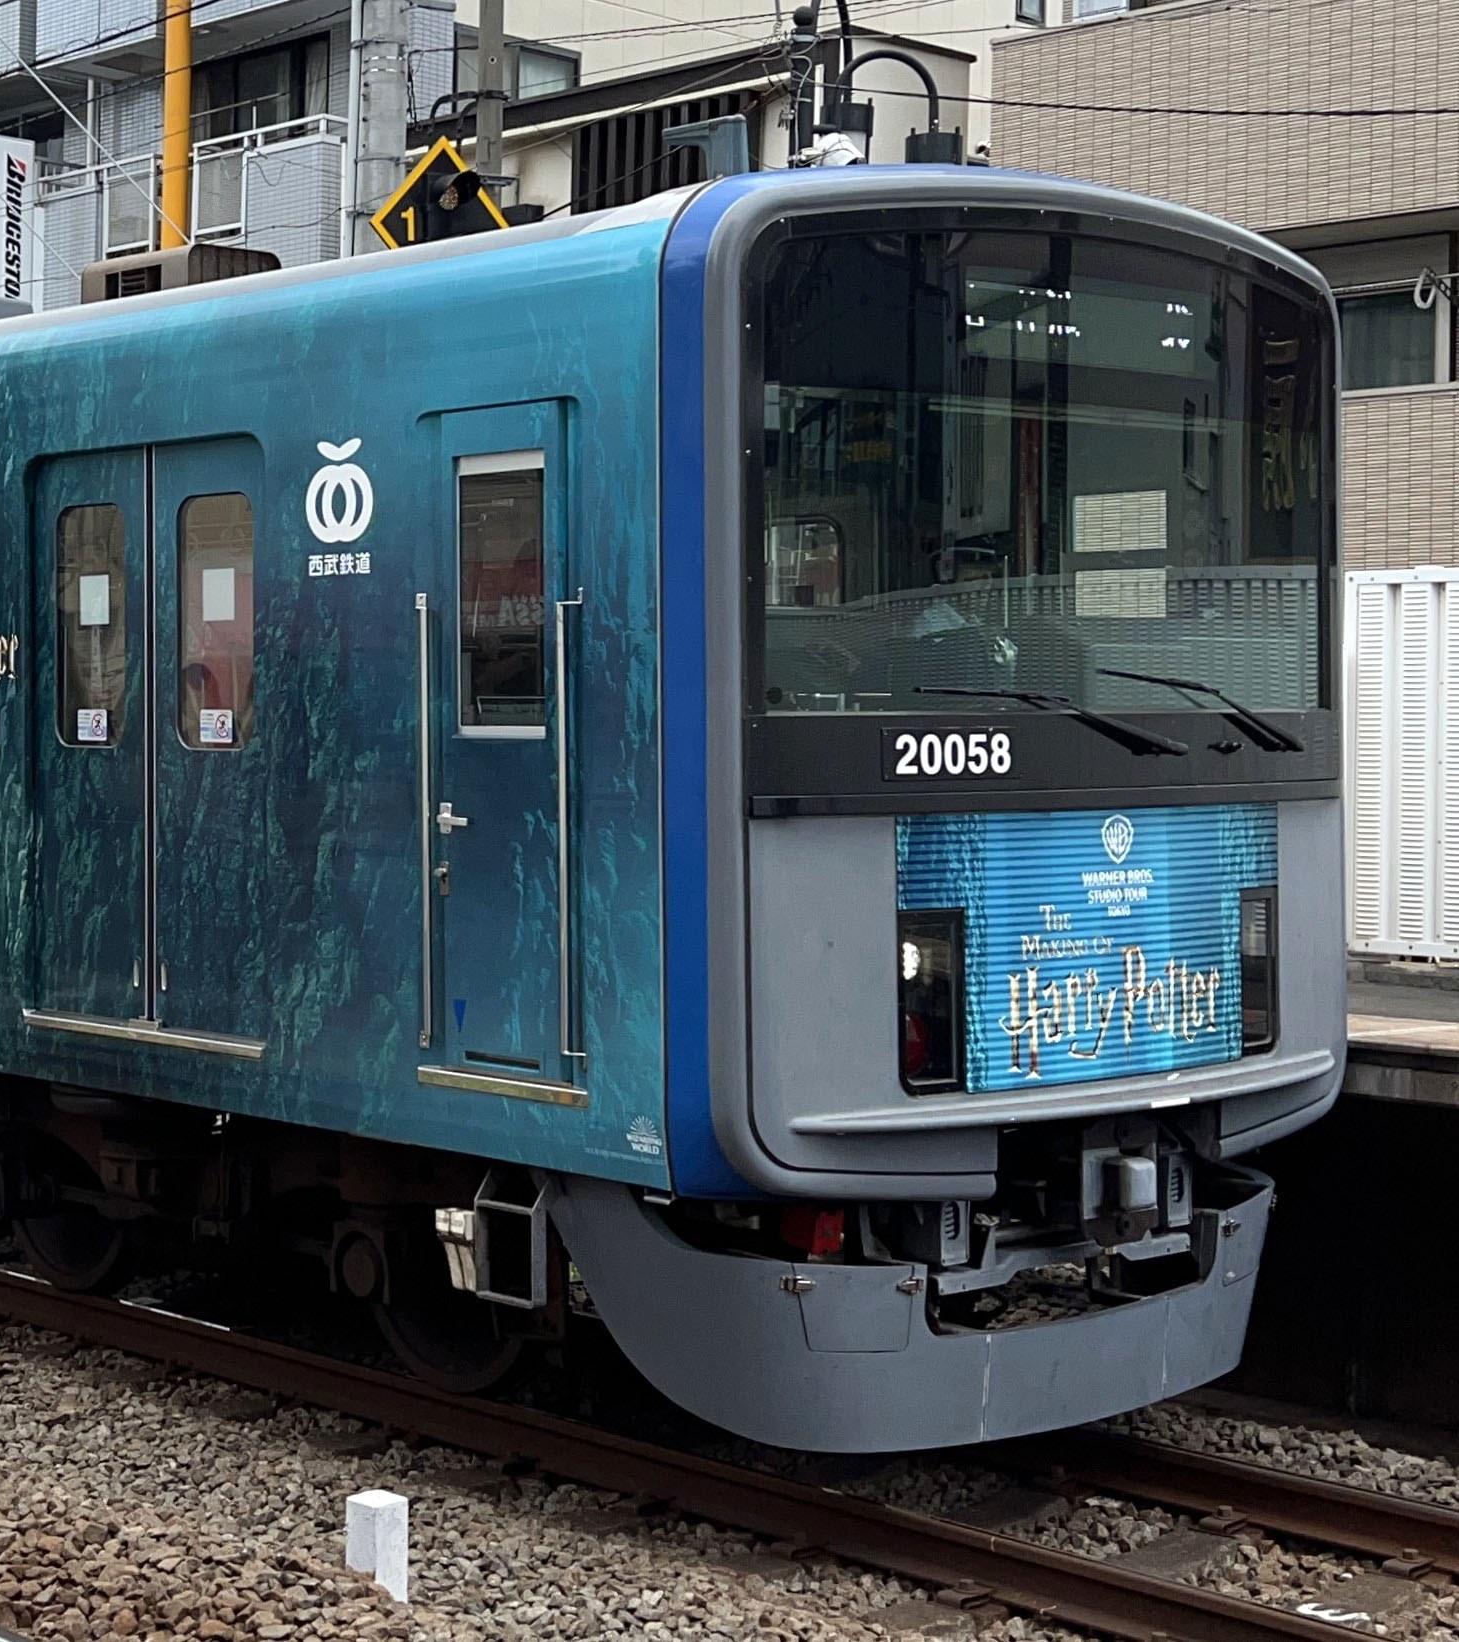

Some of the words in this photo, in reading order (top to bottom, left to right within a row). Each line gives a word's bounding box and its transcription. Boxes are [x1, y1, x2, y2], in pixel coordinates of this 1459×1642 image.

[5, 153, 27, 299] BRIDGESTO
[401, 206, 415, 241] 1
[308, 552, 372, 577] 西武鉄道
[895, 733, 1012, 775] 20058
[1081, 871, 1127, 888] WARNER
[1127, 868, 1155, 884] BROS.
[1087, 888, 1123, 904] STUDIO
[1123, 887, 1148, 901] TOUR
[998, 966, 1118, 1080] Harry
[1122, 945, 1221, 1044] Potter
